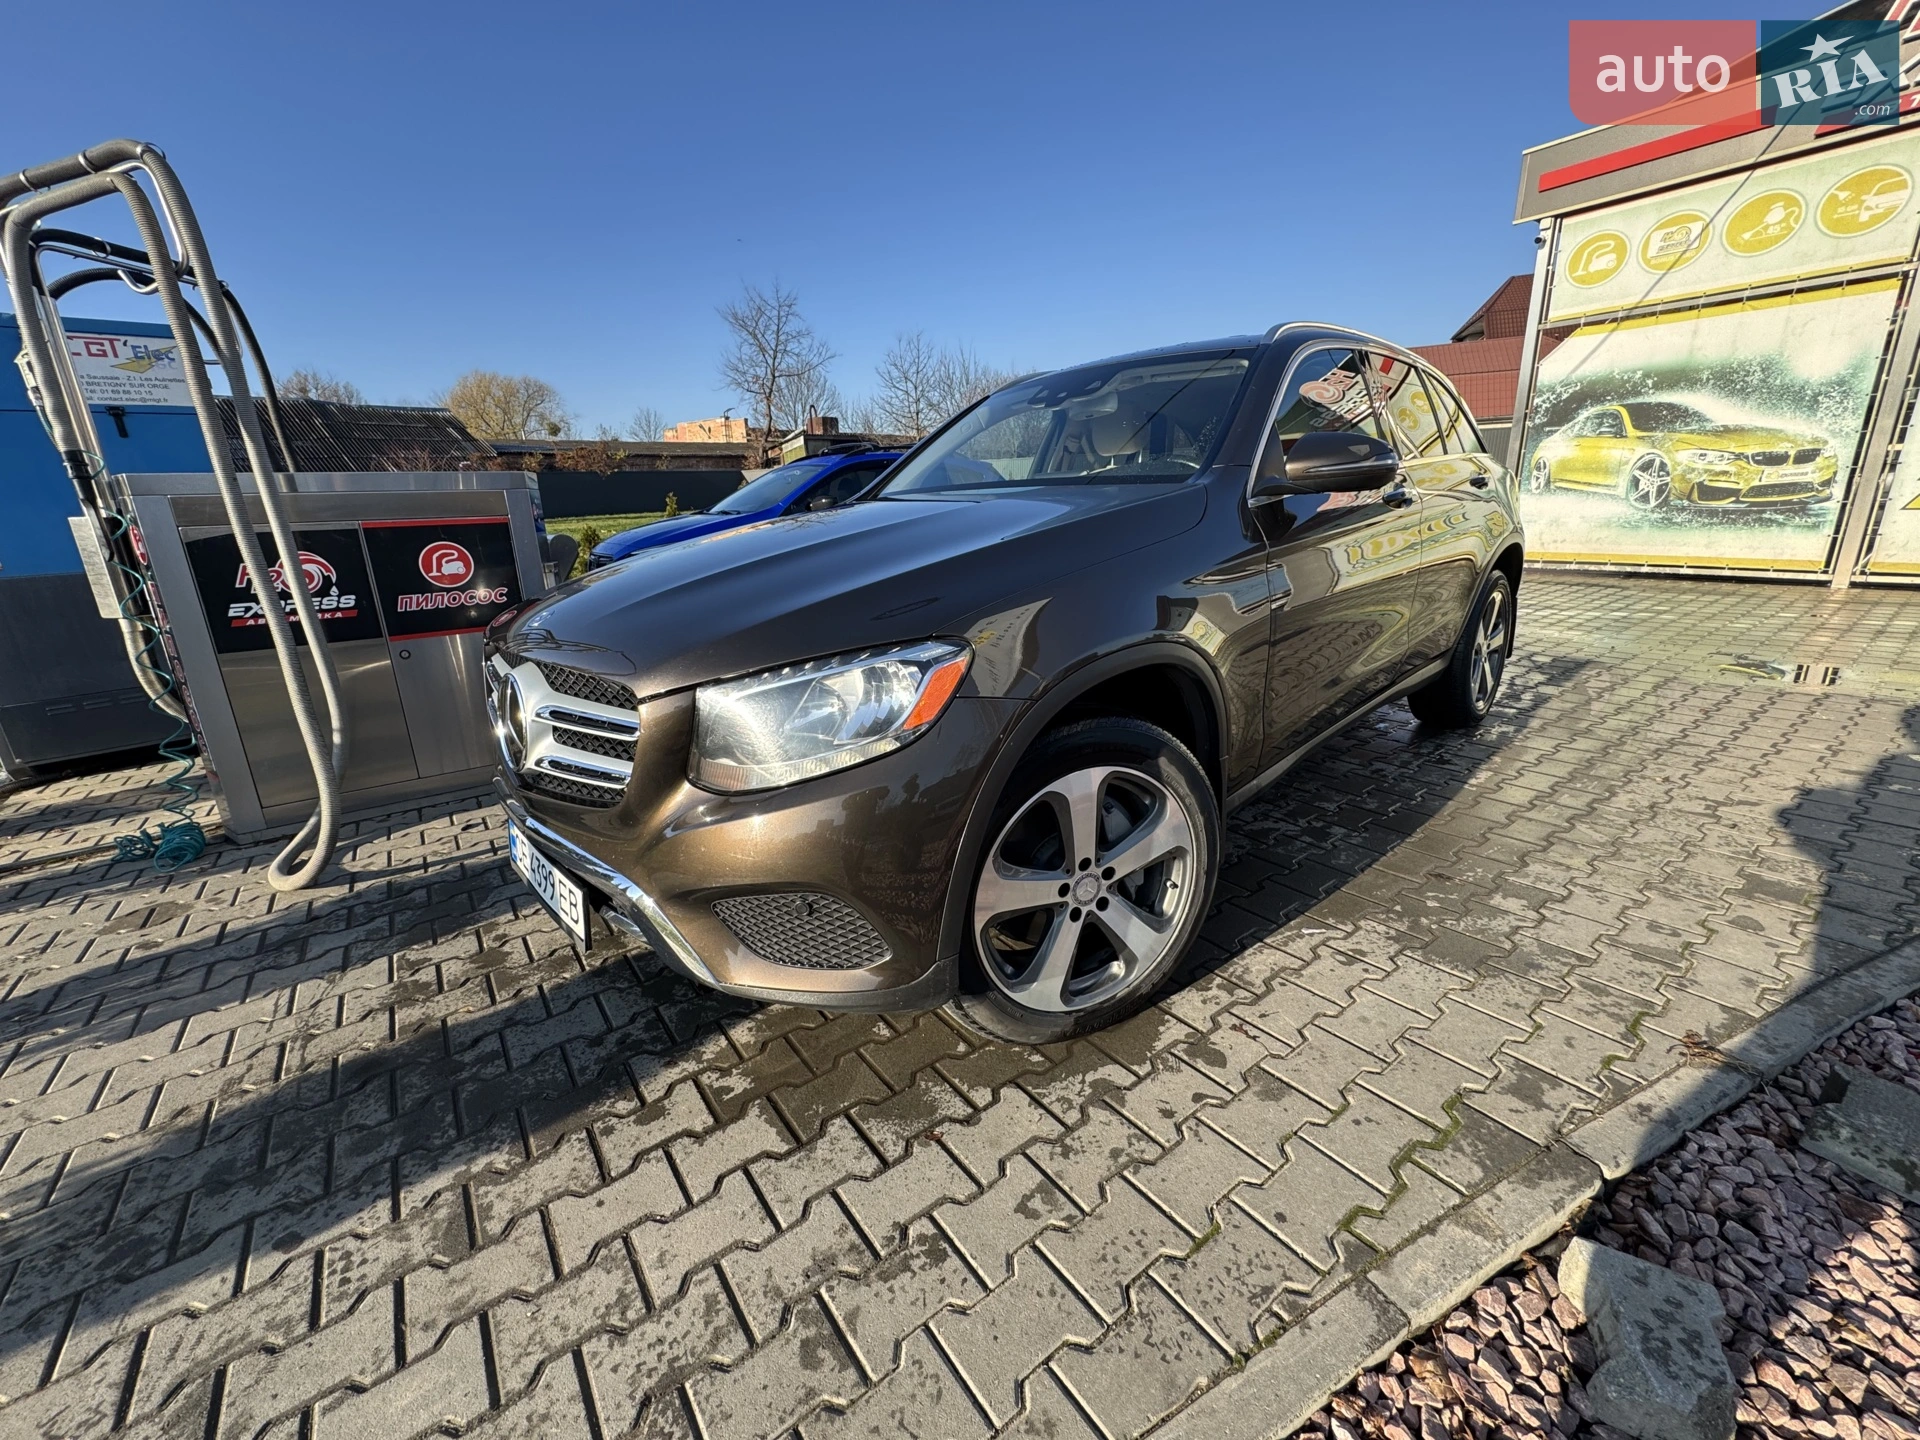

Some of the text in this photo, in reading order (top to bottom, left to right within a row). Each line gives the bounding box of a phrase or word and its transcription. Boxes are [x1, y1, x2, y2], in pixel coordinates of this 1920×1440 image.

[397, 586, 508, 613] ПИЛОСОС
[530, 851, 555, 902] 4399
[558, 877, 580, 925] EB
